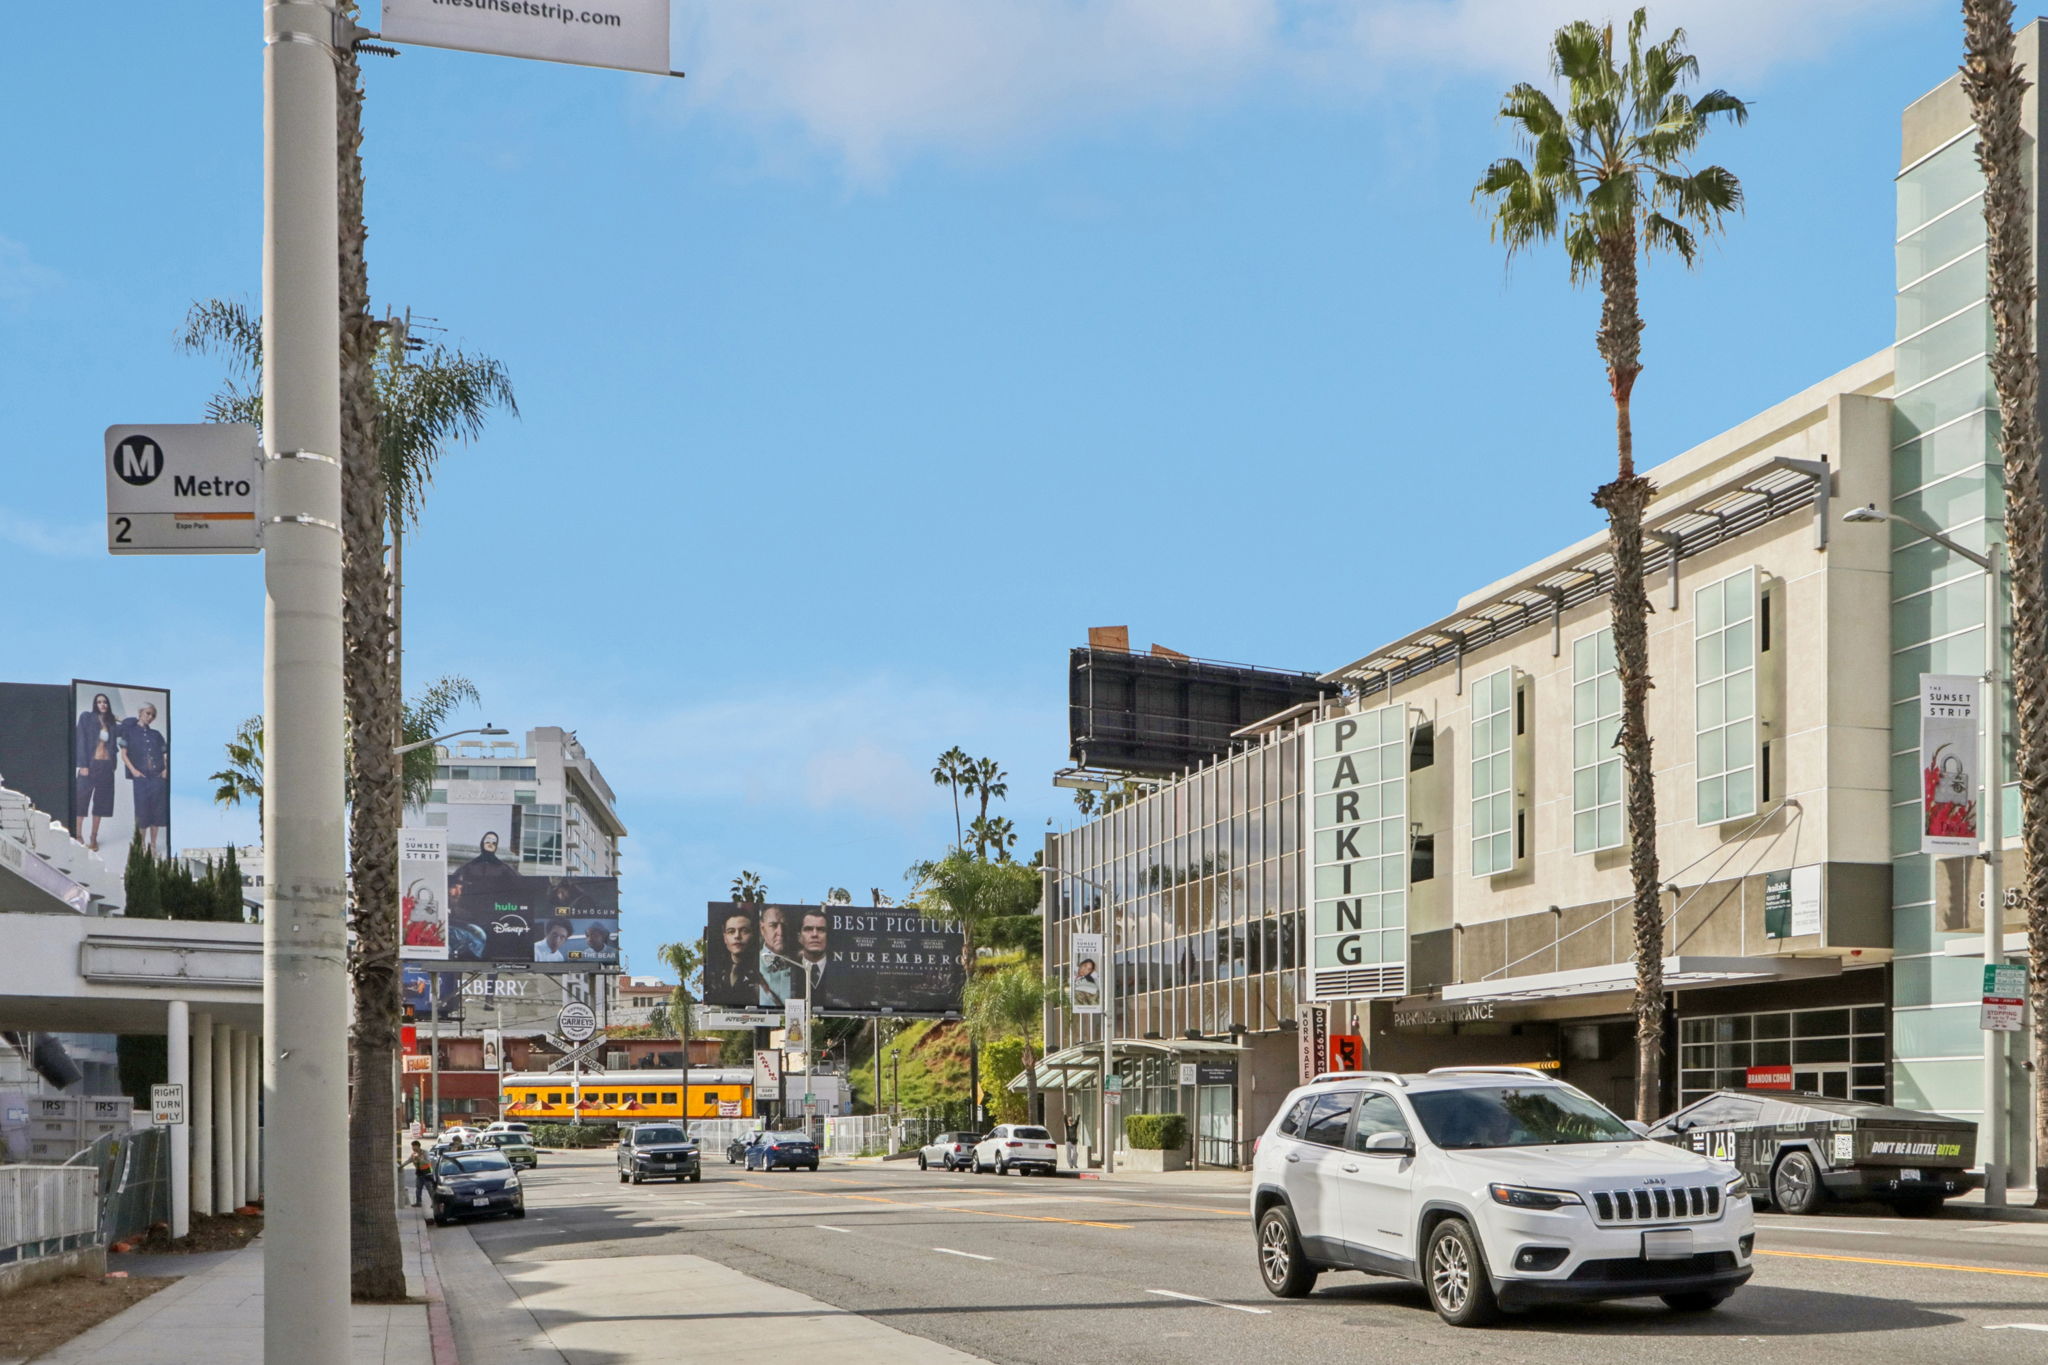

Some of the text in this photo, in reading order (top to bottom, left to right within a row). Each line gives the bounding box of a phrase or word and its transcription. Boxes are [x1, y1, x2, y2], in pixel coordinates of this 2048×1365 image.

[122, 444, 155, 477] M
[174, 475, 250, 497] Metro
[115, 517, 132, 543] 2
[1930, 693, 1971, 702] SUNSET
[1930, 708, 1971, 717] STRIP
[1332, 719, 1362, 967] PARKING
[494, 902, 518, 911] hulu
[833, 915, 878, 931] BEST
[1394, 1003, 1494, 1027] PARKING ENTRANCE
[552, 1038, 566, 1050] HOT
[1316, 1010, 1327, 1073] 23.656.7100
[555, 1040, 600, 1068] HAMBURGERS
[583, 1056, 603, 1071] DOGS
[757, 1051, 778, 1081] PARKING
[1747, 1073, 1790, 1084] BRANDON COHAN
[154, 1088, 180, 1097] RIGHT
[42, 1100, 61, 1111] IRS
[95, 1101, 114, 1112] IRS
[155, 1100, 180, 1109] TURN
[1693, 1132, 1705, 1151] HE
[1872, 1141, 1961, 1156] DON'T BE A LITTLE BITCH
